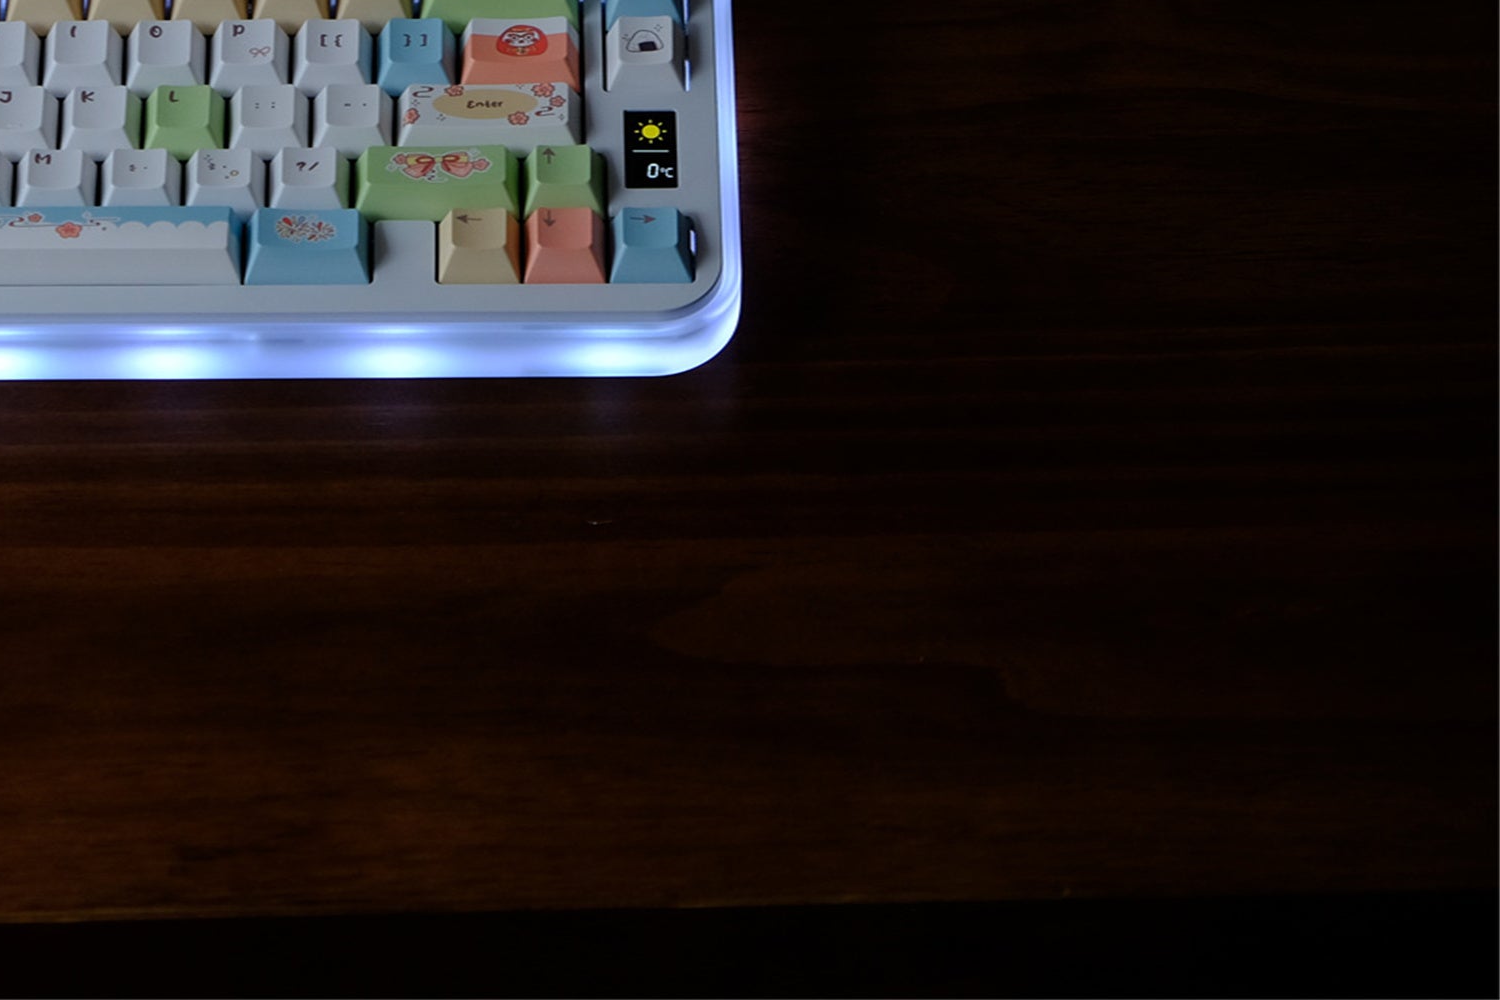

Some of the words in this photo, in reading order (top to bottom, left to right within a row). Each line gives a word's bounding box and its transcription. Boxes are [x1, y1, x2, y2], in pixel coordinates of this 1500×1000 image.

[148, 25, 163, 39] O
[232, 24, 246, 38] P
[80, 90, 95, 103] K
[168, 90, 179, 103] L
[466, 100, 503, 110] Enter
[34, 152, 52, 165] M
